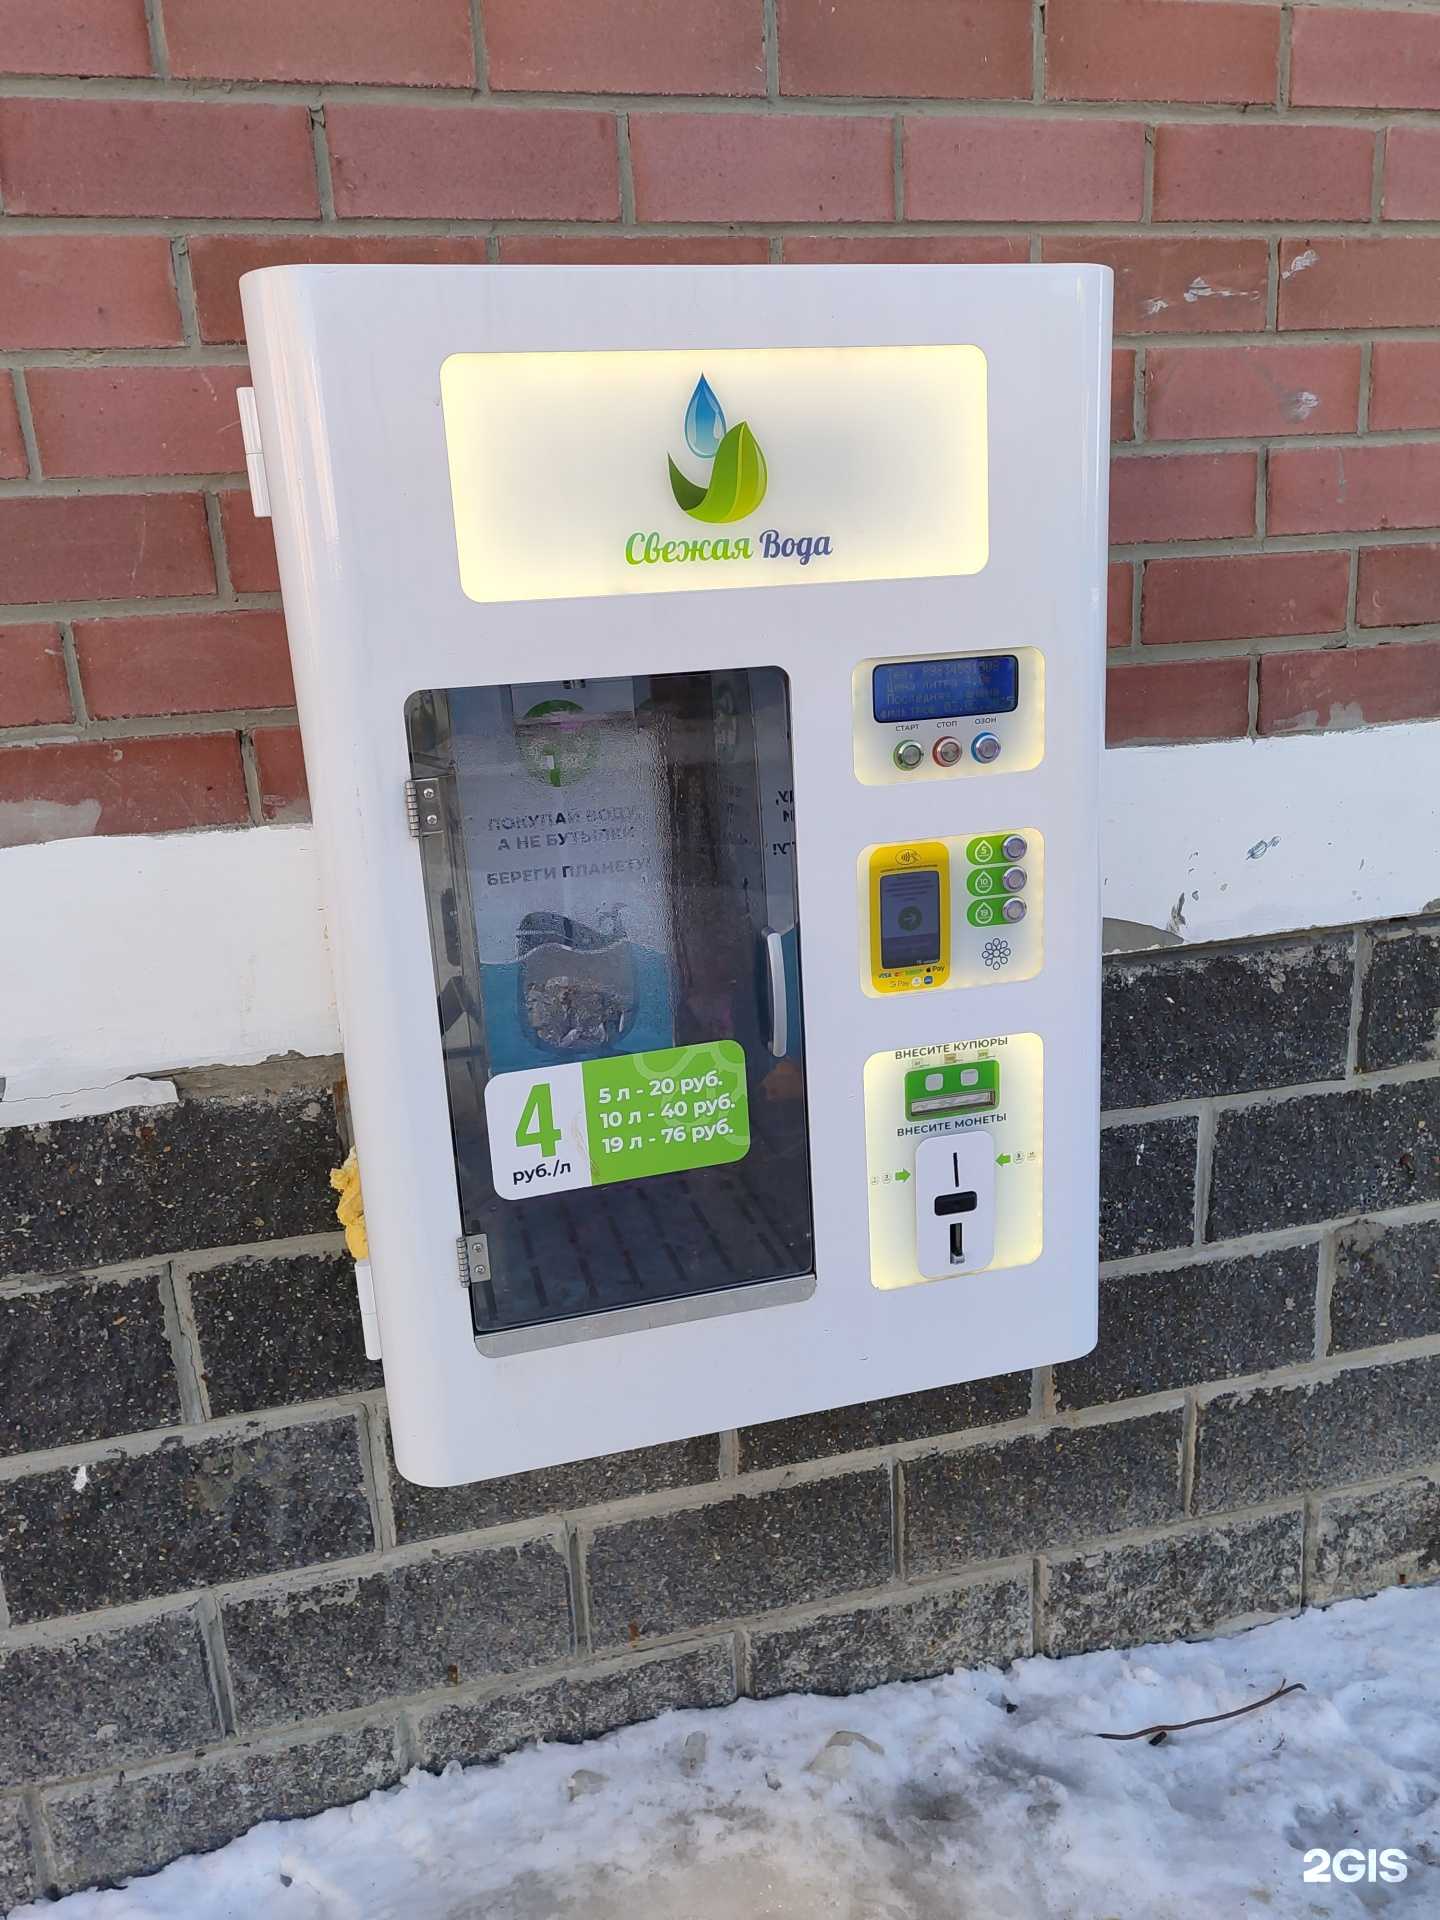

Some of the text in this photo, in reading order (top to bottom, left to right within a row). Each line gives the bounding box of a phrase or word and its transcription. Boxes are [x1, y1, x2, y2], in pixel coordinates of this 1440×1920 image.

[625, 529, 833, 566] Свежая Вода
[896, 723, 920, 732] СТАРТ
[936, 720, 958, 729] СТОП
[974, 717, 997, 725] ОЗОН
[497, 838, 511, 851] А
[515, 834, 542, 850] НЕ
[487, 866, 557, 887] БЕРЕГИ
[895, 1043, 950, 1060] ВНЕСИТЕ
[953, 1036, 1009, 1053] КУПЮРЫ
[599, 1088, 612, 1104] 5
[617, 1088, 630, 1102] л
[649, 1077, 675, 1096] 20
[680, 1070, 723, 1094] руб.
[515, 1081, 562, 1158] 4
[600, 1111, 623, 1129] 10
[628, 1111, 641, 1125] л
[661, 1101, 688, 1119] 40
[693, 1093, 736, 1117] руб.
[602, 1136, 624, 1154] 19
[629, 1135, 642, 1150] л
[661, 1126, 687, 1145] 76
[691, 1118, 734, 1143] руб.
[897, 1113, 1007, 1137] ВНЕСИТЕ МОНЕТЫ
[513, 1160, 571, 1185] руб./л
